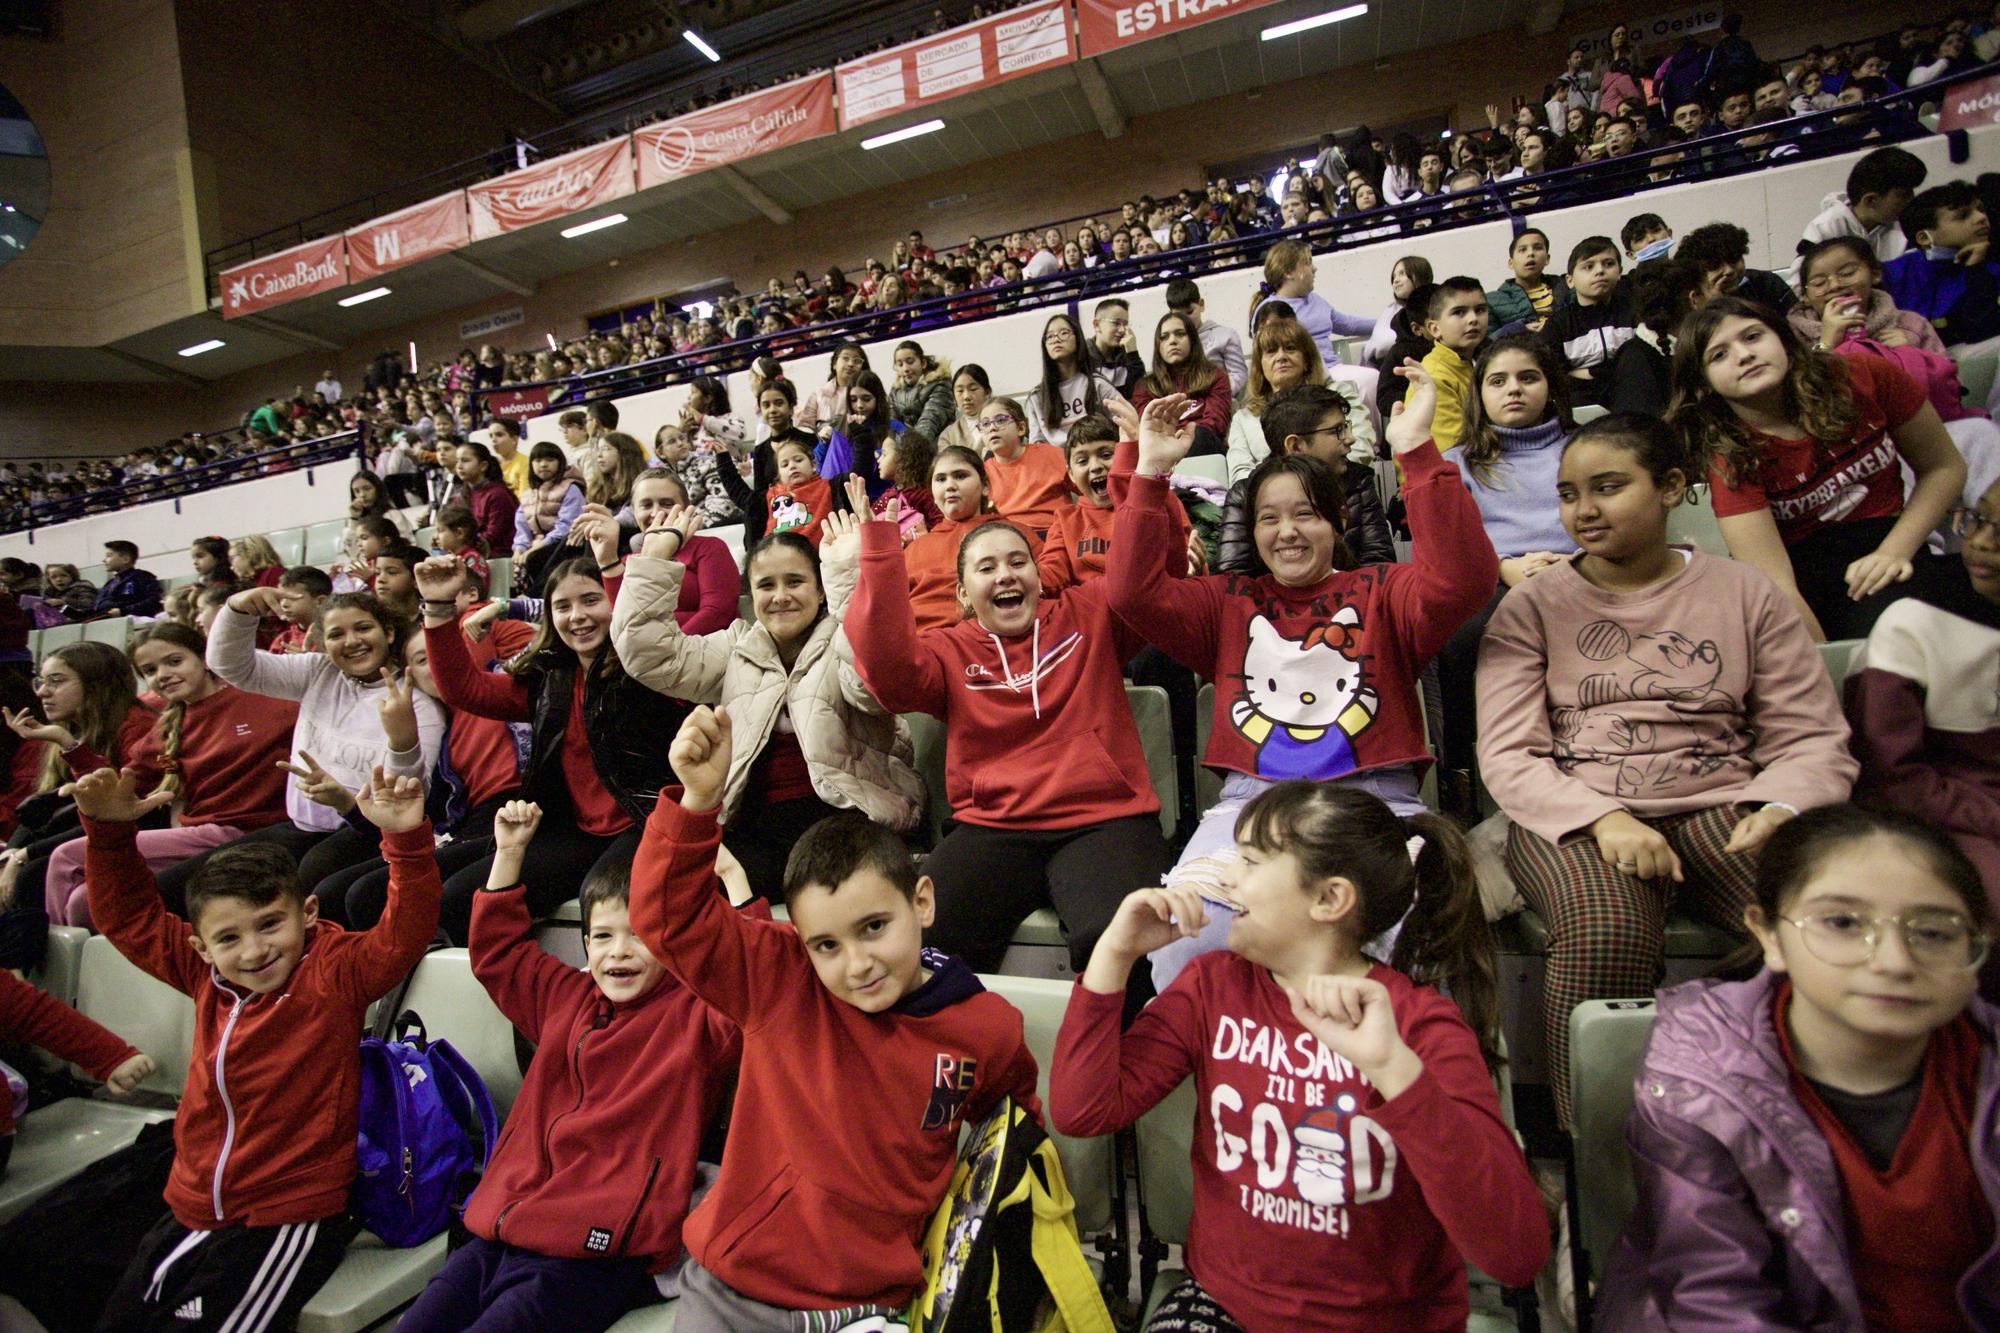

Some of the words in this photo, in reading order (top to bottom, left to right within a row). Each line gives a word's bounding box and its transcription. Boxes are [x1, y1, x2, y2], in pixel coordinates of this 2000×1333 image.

[920, 42, 968, 61] MERCADO
[1002, 48, 1053, 69] CORREOS
[702, 126, 749, 149] Costa
[251, 253, 339, 299] CaixaBank
[500, 401, 543, 415] MÓDULO
[1212, 1015, 1294, 1075] DEAR
[1265, 1074, 1295, 1103] I'LL
[1305, 1081, 1326, 1107] BE
[1252, 1190, 1350, 1240] PROMISE!
[588, 1236, 609, 1246] and
[590, 1230, 610, 1240] here
[586, 1242, 607, 1252] now
